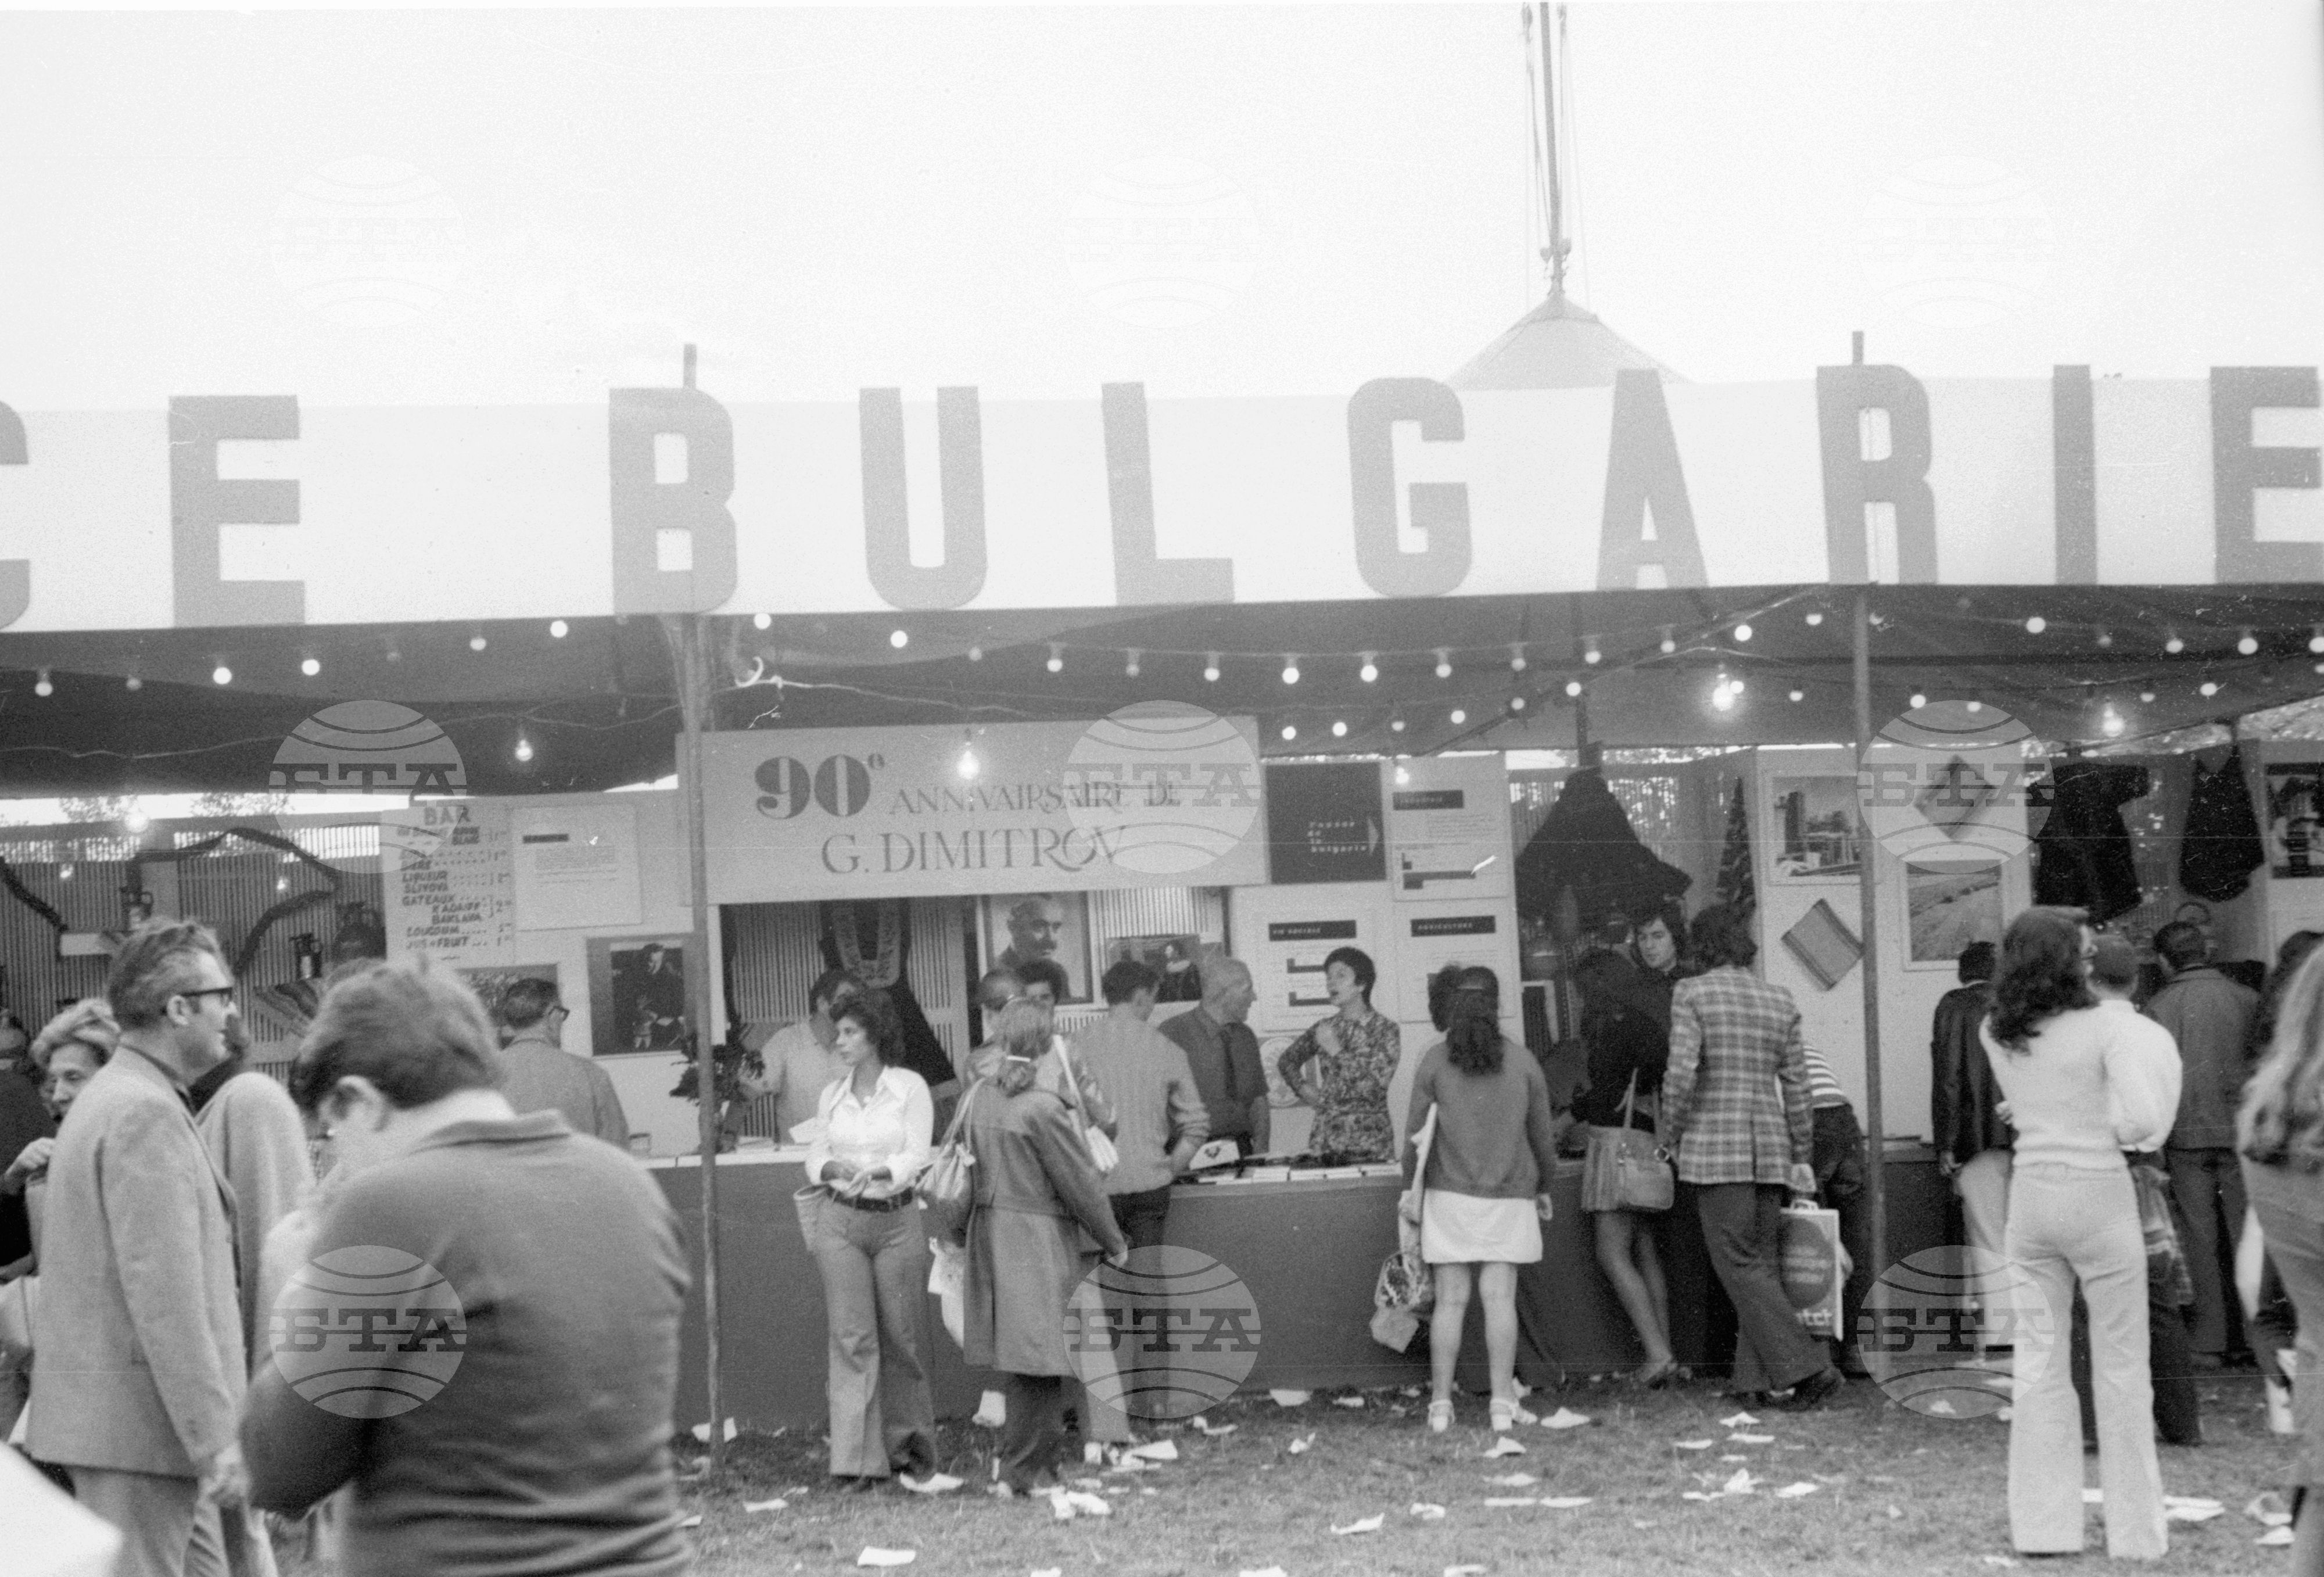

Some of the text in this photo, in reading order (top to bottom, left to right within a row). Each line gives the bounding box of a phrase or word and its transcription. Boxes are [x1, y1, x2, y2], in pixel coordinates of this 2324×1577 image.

[0, 364, 2324, 629] E BULGARIE
[424, 806, 471, 826] BAR
[822, 826, 1126, 874] G. DIMITROV
